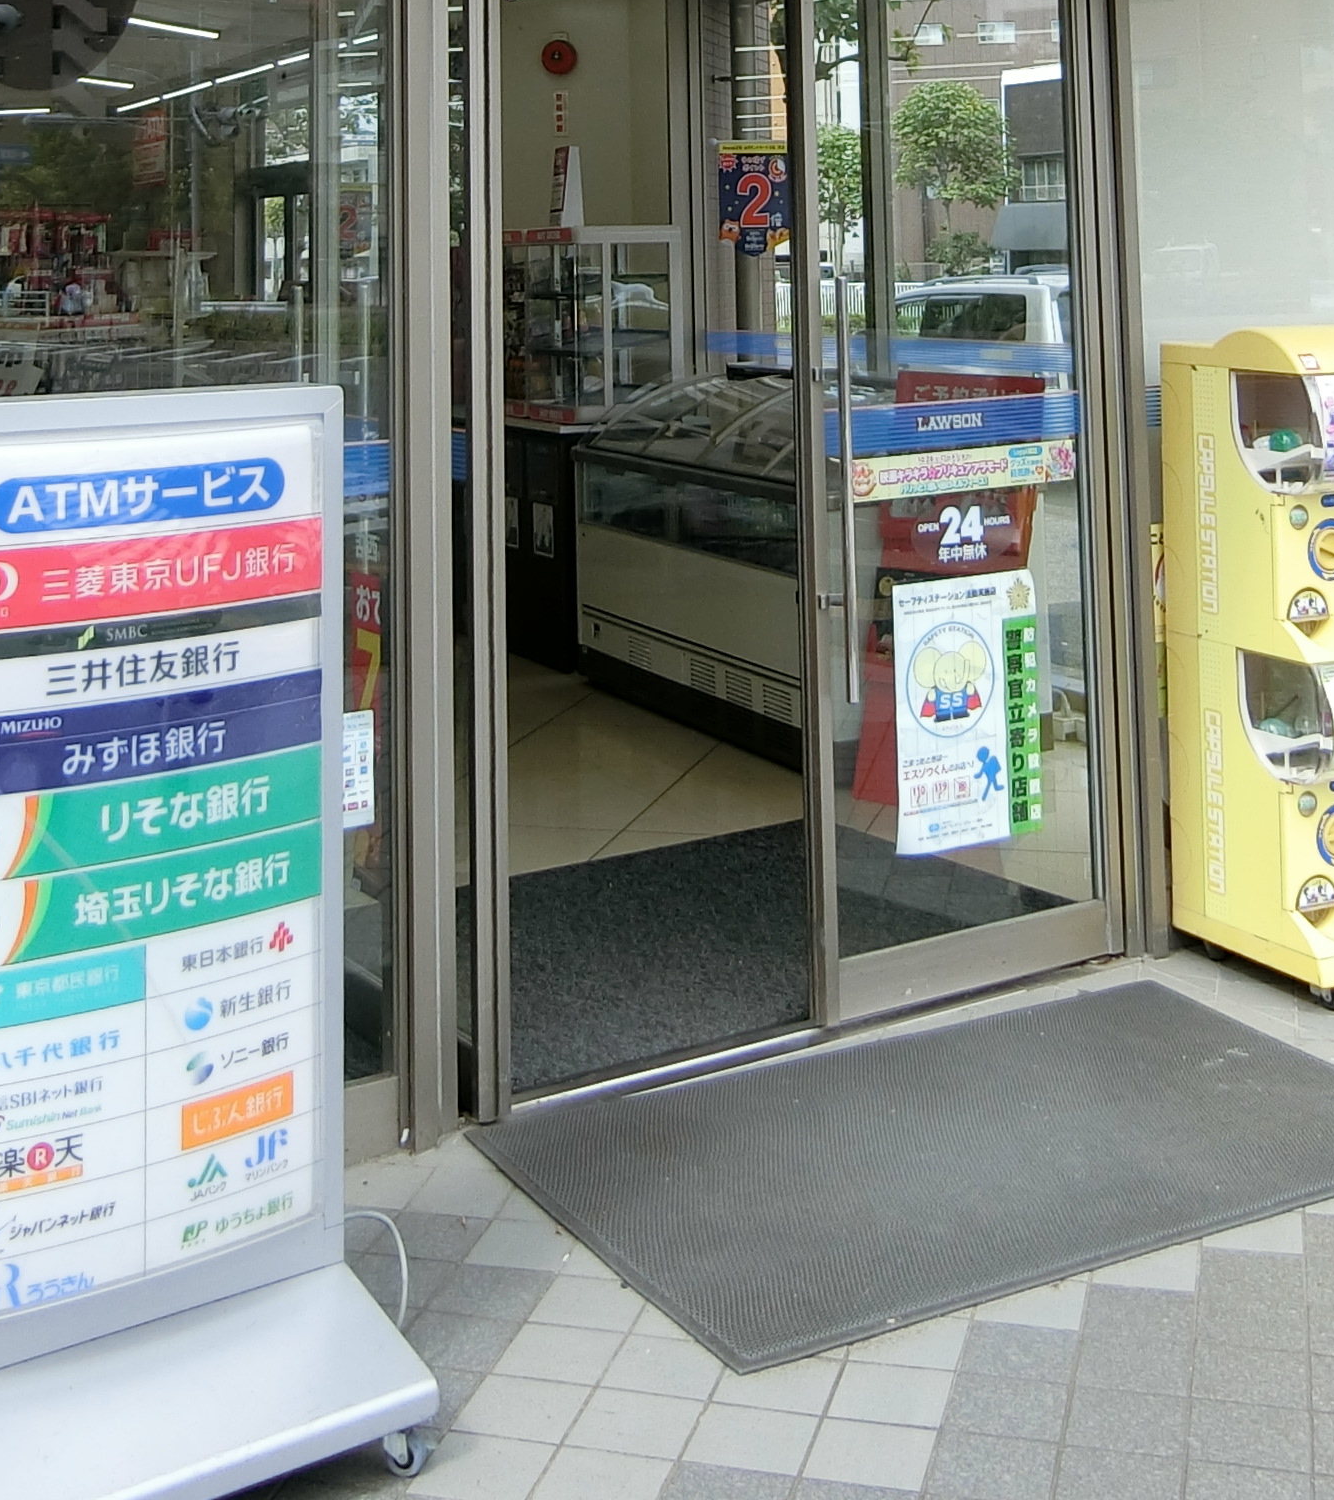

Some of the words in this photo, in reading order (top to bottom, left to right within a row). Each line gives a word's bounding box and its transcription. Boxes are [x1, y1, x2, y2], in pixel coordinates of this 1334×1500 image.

[736, 172, 772, 228] 2
[916, 412, 984, 432] LAWSON
[6, 464, 271, 525] ATMサービス
[1197, 433, 1217, 527] CAPSULE
[917, 521, 940, 534] OPEN
[939, 505, 985, 545] 24
[983, 514, 1011, 527] HOURS
[41, 543, 297, 603] 三菱東京UFJ銀行
[937, 543, 988, 564] 年中無休
[1199, 528, 1219, 615] STATION
[105, 623, 149, 642] SMBC
[45, 640, 241, 697] 三井住友銀行
[939, 691, 964, 709] SS
[0, 715, 63, 736] MIZUHO
[61, 719, 227, 776] みずほ銀行
[1203, 708, 1224, 807] CAPSULE
[100, 776, 271, 844] りそな銀行
[1206, 806, 1227, 896] STATION
[74, 850, 291, 928] 埼玉りそな銀行
[181, 936, 265, 972] 東日本銀行
[15, 963, 120, 999] 東京都民銀行
[219, 979, 292, 1020] 新生銀行
[220, 1031, 290, 1070] ソニー銀行
[5, 1111, 61, 1132] Sumishin
[61, 1109, 79, 1120] Net
[79, 1104, 103, 1117] Bank
[192, 1085, 285, 1136] じぶん銀行
[244, 1159, 290, 1182] マリンバンク
[189, 1181, 228, 1203] JAバンク
[215, 1190, 295, 1235] ゆうちょ銀行
[9, 1200, 117, 1241] ジャパンネット銀行
[26, 1271, 96, 1300] ろうきん
